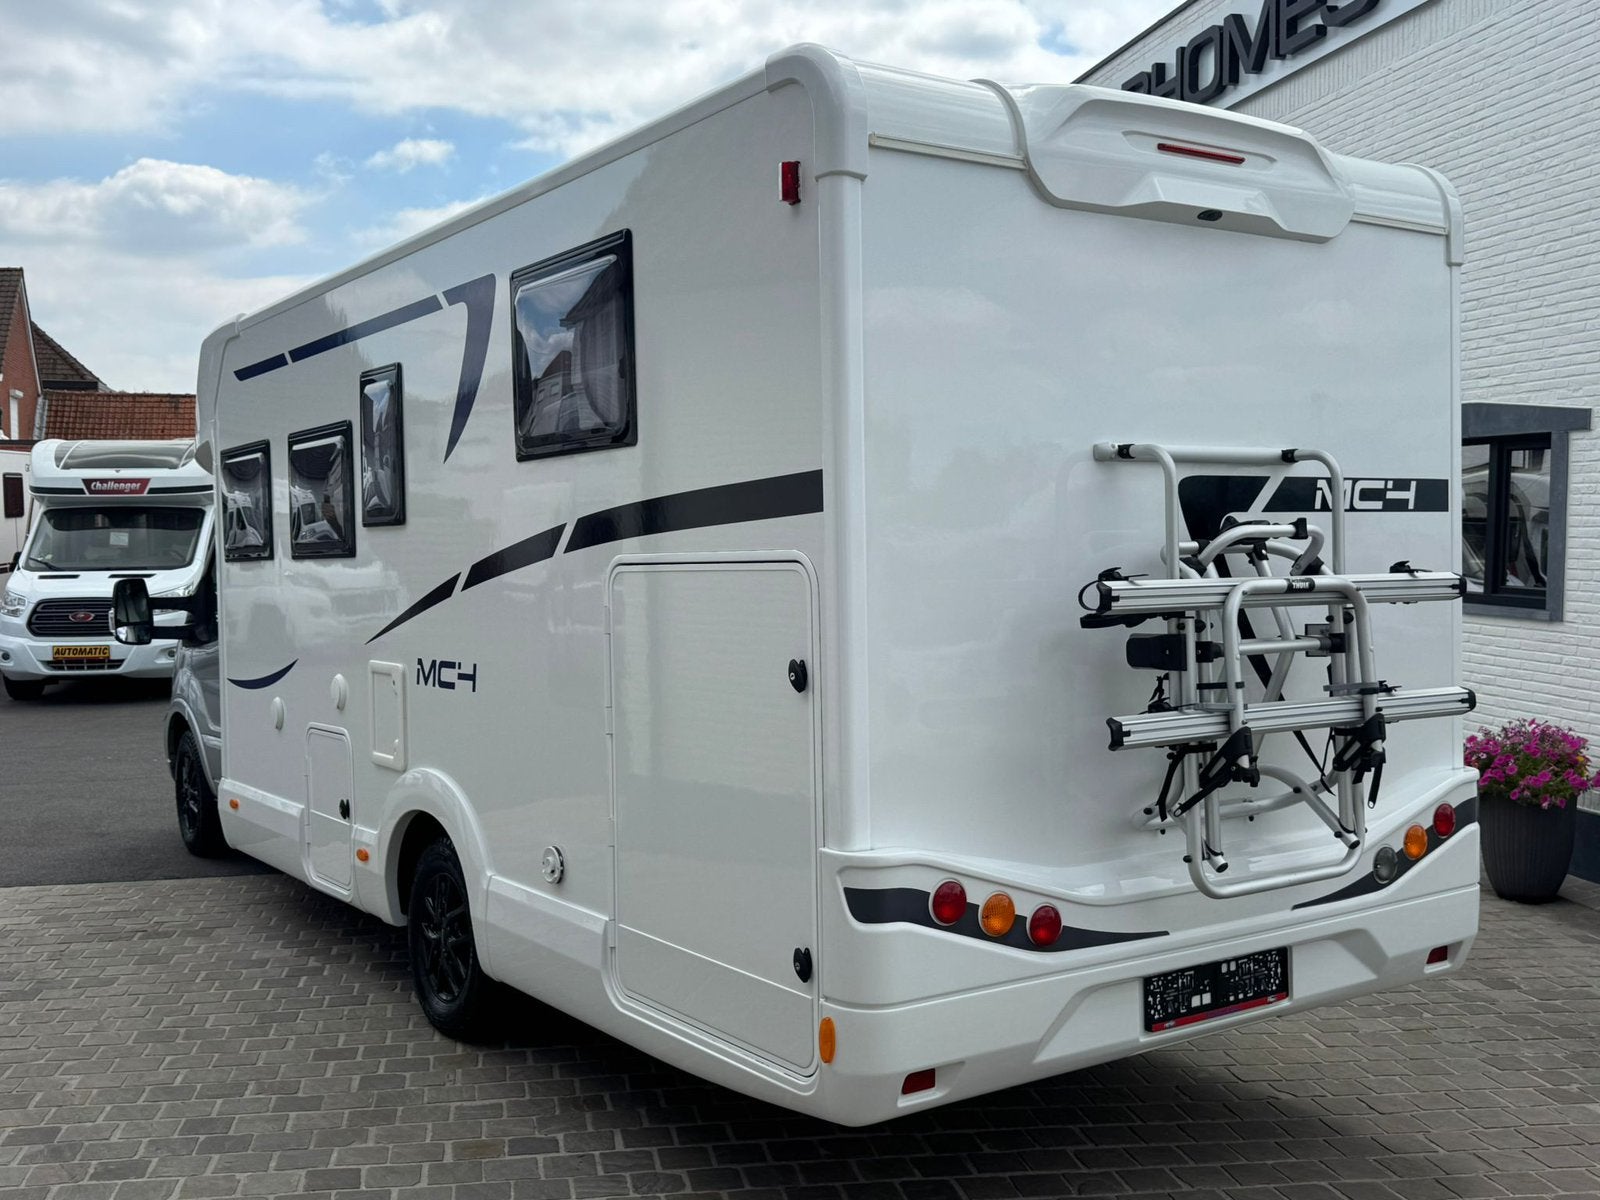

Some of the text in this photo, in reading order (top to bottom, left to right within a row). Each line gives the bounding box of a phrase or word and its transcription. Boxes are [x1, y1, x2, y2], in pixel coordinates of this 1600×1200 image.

[91, 481, 141, 493] Challenger
[1315, 479, 1416, 510] MC4
[54, 647, 108, 656] AUTOMATIC
[417, 658, 476, 692] MC4
